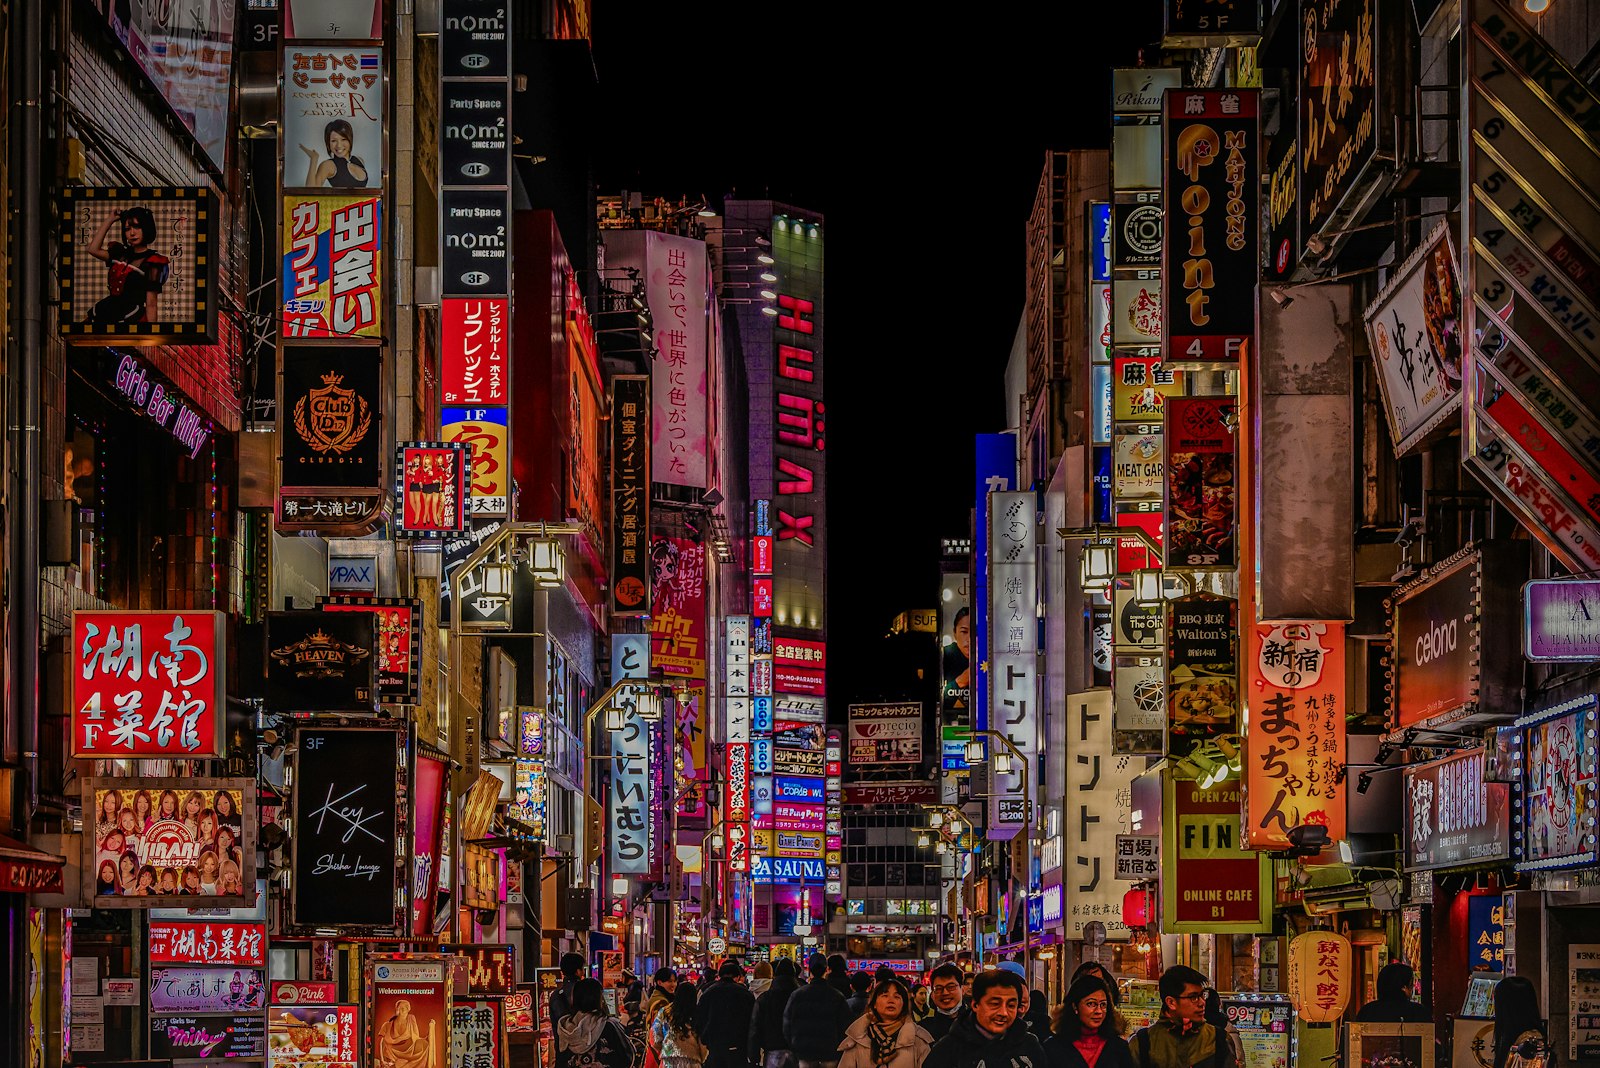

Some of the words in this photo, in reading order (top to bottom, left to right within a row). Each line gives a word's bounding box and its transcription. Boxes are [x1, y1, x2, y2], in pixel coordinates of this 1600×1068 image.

[468, 56, 483, 66] 5F
[1479, 61, 1505, 87] 7
[450, 99, 472, 110] Party
[474, 99, 502, 110] Space
[1184, 94, 1241, 115] 麻雀
[1137, 116, 1159, 125] 7F
[1480, 114, 1507, 142] 6
[468, 165, 483, 175] 4F
[1224, 129, 1247, 251] MAHJONG
[1480, 169, 1507, 196] 5
[1137, 193, 1159, 203] 6F
[450, 208, 472, 218] Party
[474, 208, 502, 218] Space
[1176, 123, 1220, 327] Point
[1480, 222, 1507, 249] 4
[292, 201, 319, 299] カフェ
[332, 199, 377, 336] 出会い
[1137, 270, 1159, 279] 5F
[468, 273, 483, 284] 3F
[1481, 278, 1507, 304] 3
[285, 299, 326, 314] キラリ
[1530, 274, 1596, 341] センチュリー
[464, 301, 483, 402] リフレッシュ
[1137, 347, 1160, 357] 4F
[666, 247, 689, 475] 出会いで、世界に色がついた
[489, 364, 501, 399] ホステル
[1122, 362, 1175, 386] 麻雀
[445, 392, 458, 402] 2F
[115, 354, 150, 407] Girls
[146, 384, 175, 426] Bar
[172, 404, 208, 460] Milky
[465, 409, 487, 421] 1F
[1137, 424, 1161, 435] 3F
[1117, 463, 1143, 478] MEAT
[621, 401, 637, 565] 個室ダイニング居酒屋
[284, 500, 373, 517] 第一大滝ビル
[1138, 502, 1161, 512] 2F
[1186, 553, 1220, 565] 3F
[1130, 620, 1145, 629] The
[1178, 614, 1203, 624] BBQ
[1007, 626, 1024, 657] 酒場
[1176, 627, 1228, 640] Walton's
[1415, 618, 1458, 667] celona
[82, 615, 208, 689] 湖南
[294, 650, 345, 663] HEAVEN
[775, 644, 823, 662] 全店営業中
[1262, 640, 1321, 673] 新宿
[1138, 657, 1162, 667] B1
[1283, 670, 1302, 687] の
[305, 737, 325, 750] 3F
[1260, 692, 1304, 833] まっちゃん
[729, 745, 746, 808] 横浜家系
[856, 786, 936, 796] ゴールドラッシュ
[872, 795, 910, 803] ハンバーグ
[1077, 704, 1101, 893] トントン
[1191, 790, 1219, 803] OPEN
[308, 782, 385, 843] Key
[774, 860, 824, 877] SAUNA
[1183, 889, 1222, 901] ONLINE
[1225, 889, 1253, 901] CAFE
[1211, 905, 1225, 918] B1
[151, 943, 166, 954] 4F
[1316, 940, 1341, 1011] 鉄なべ餃子
[298, 986, 325, 1000] Pink
